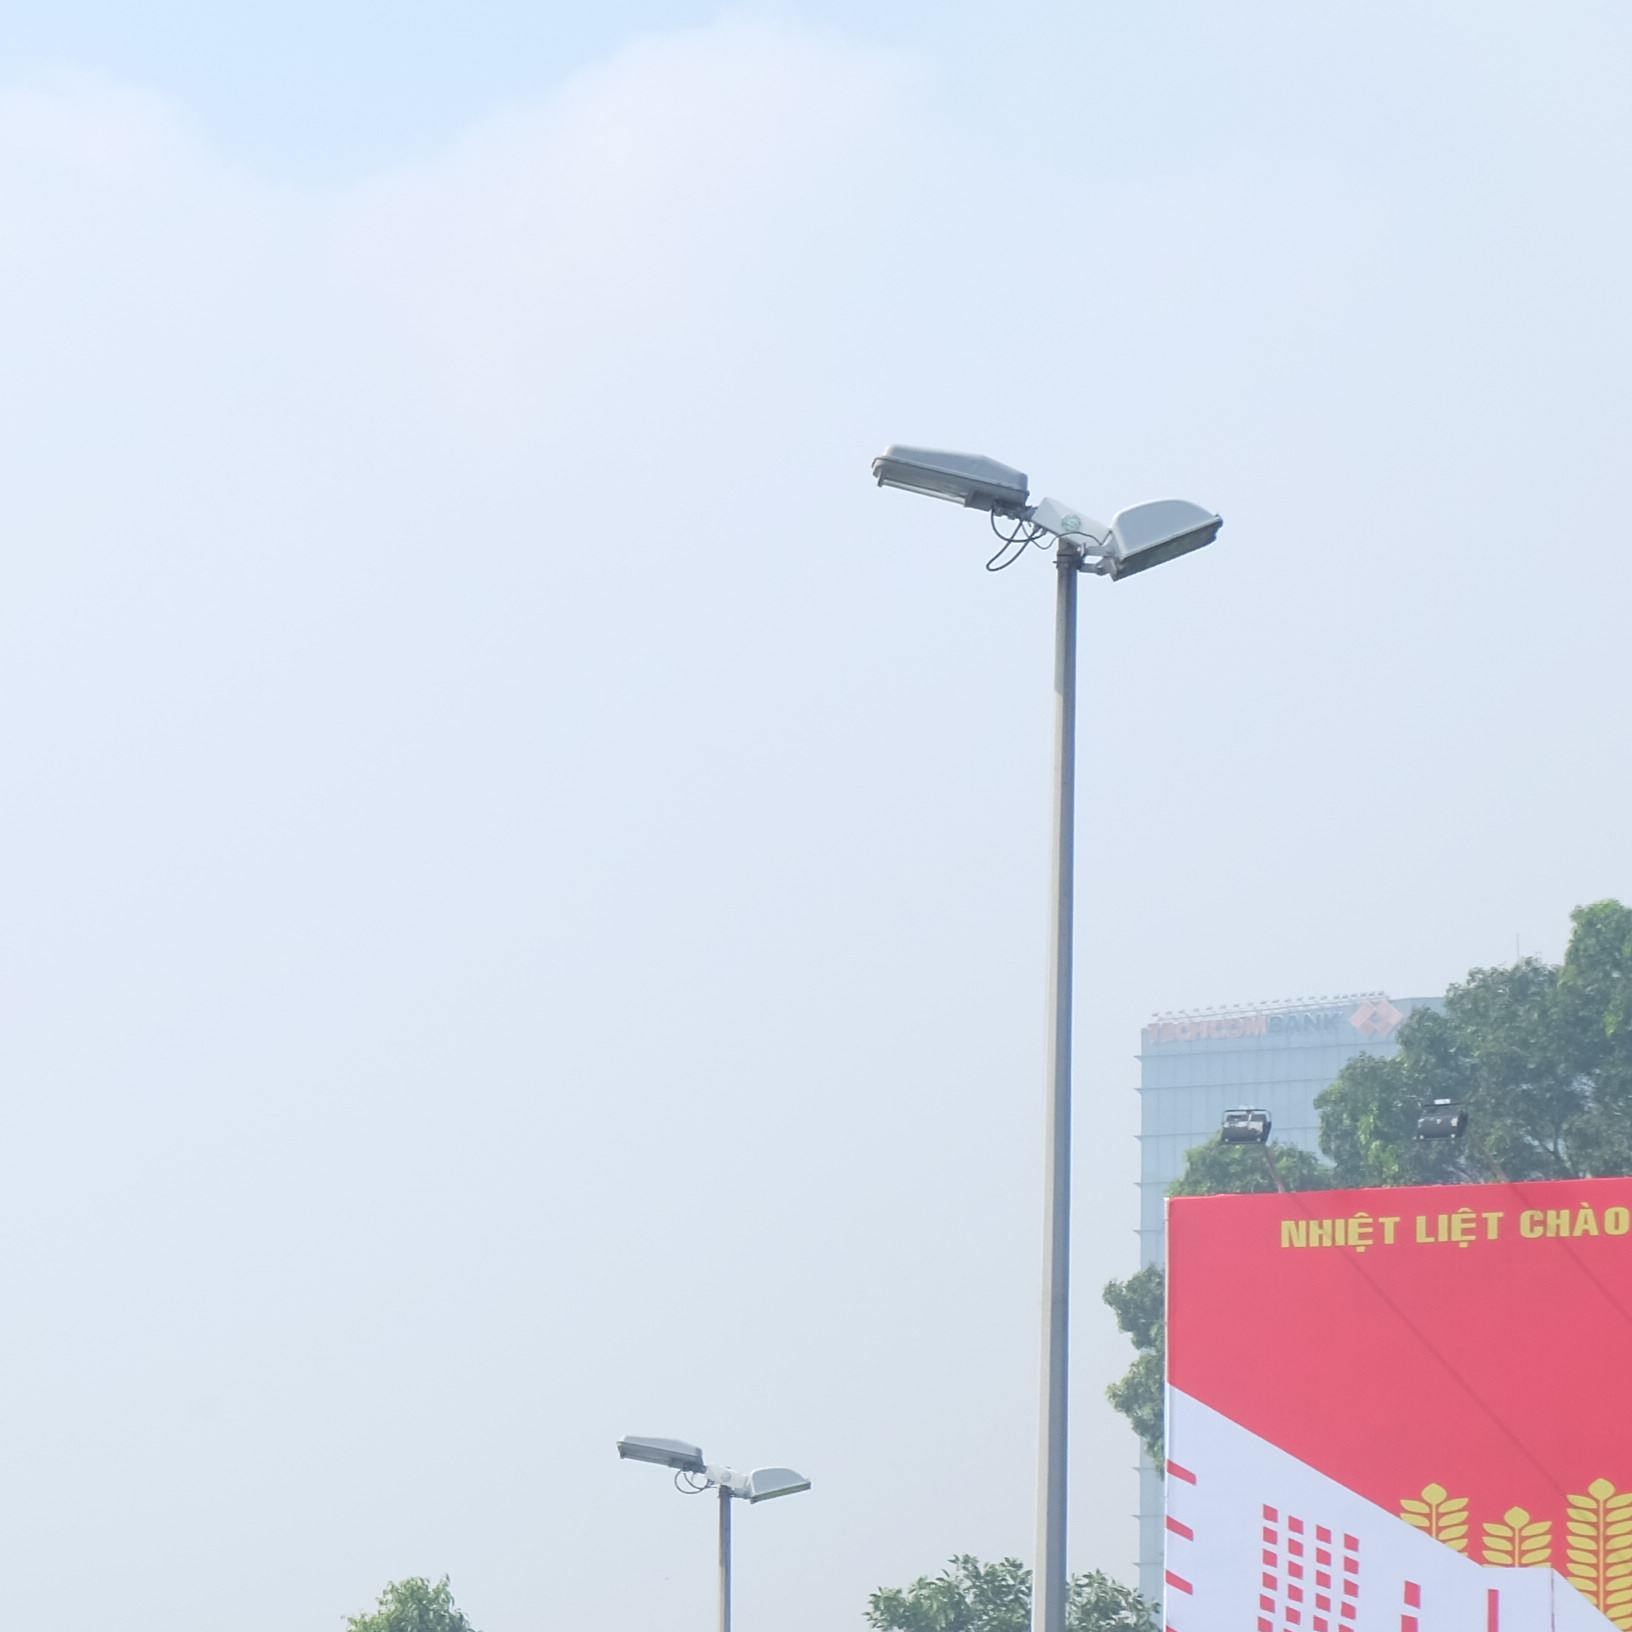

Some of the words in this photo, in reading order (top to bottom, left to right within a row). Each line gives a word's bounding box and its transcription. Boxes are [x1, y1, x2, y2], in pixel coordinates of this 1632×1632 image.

[1148, 1011, 1344, 1043] TECHCOMBANK
[1280, 1212, 1401, 1253] NHIỆT
[1415, 1208, 1504, 1248] LIỆT
[1519, 1202, 1631, 1239] CHÀO
